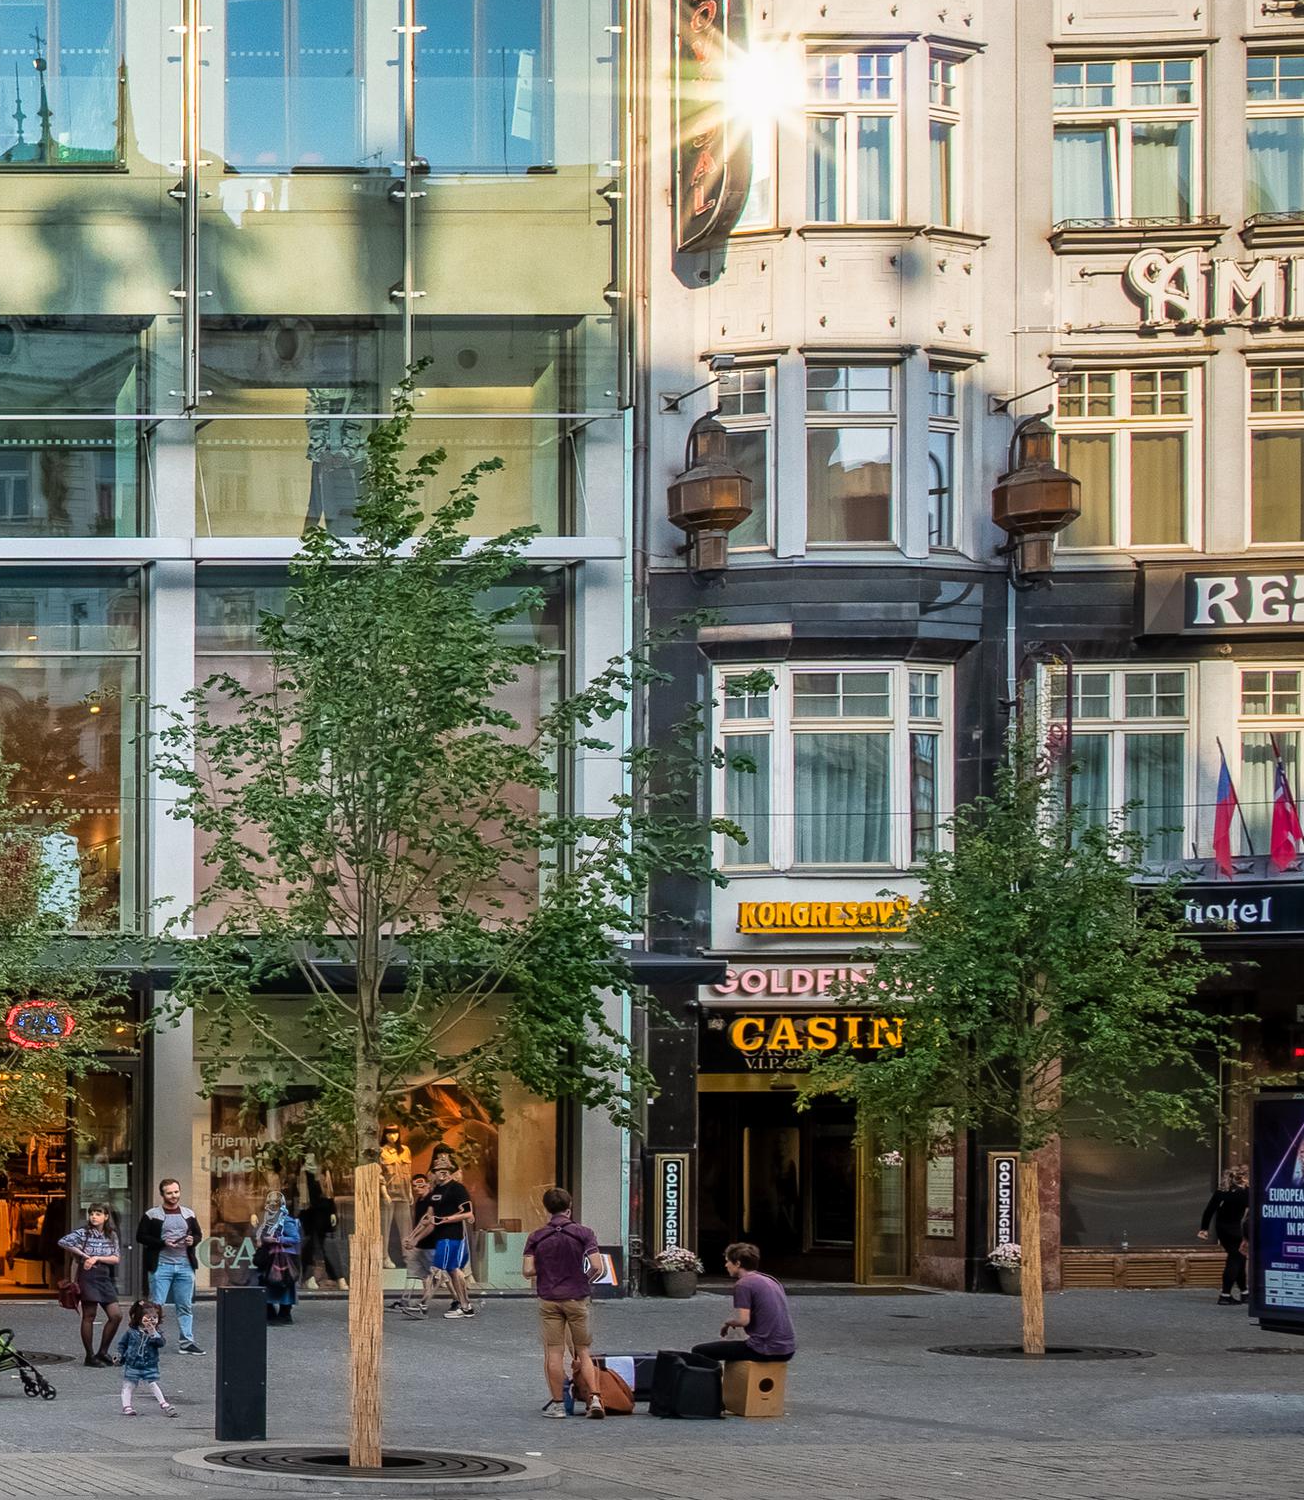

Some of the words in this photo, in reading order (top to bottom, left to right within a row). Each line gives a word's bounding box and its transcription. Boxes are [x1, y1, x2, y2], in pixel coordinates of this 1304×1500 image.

[1184, 896, 1272, 923] hotel
[713, 968, 936, 994] GOLDFIN
[730, 1017, 940, 1051] CASIN
[999, 1161, 1011, 1246] GOLDFINGER
[195, 1237, 258, 1269] C&A
